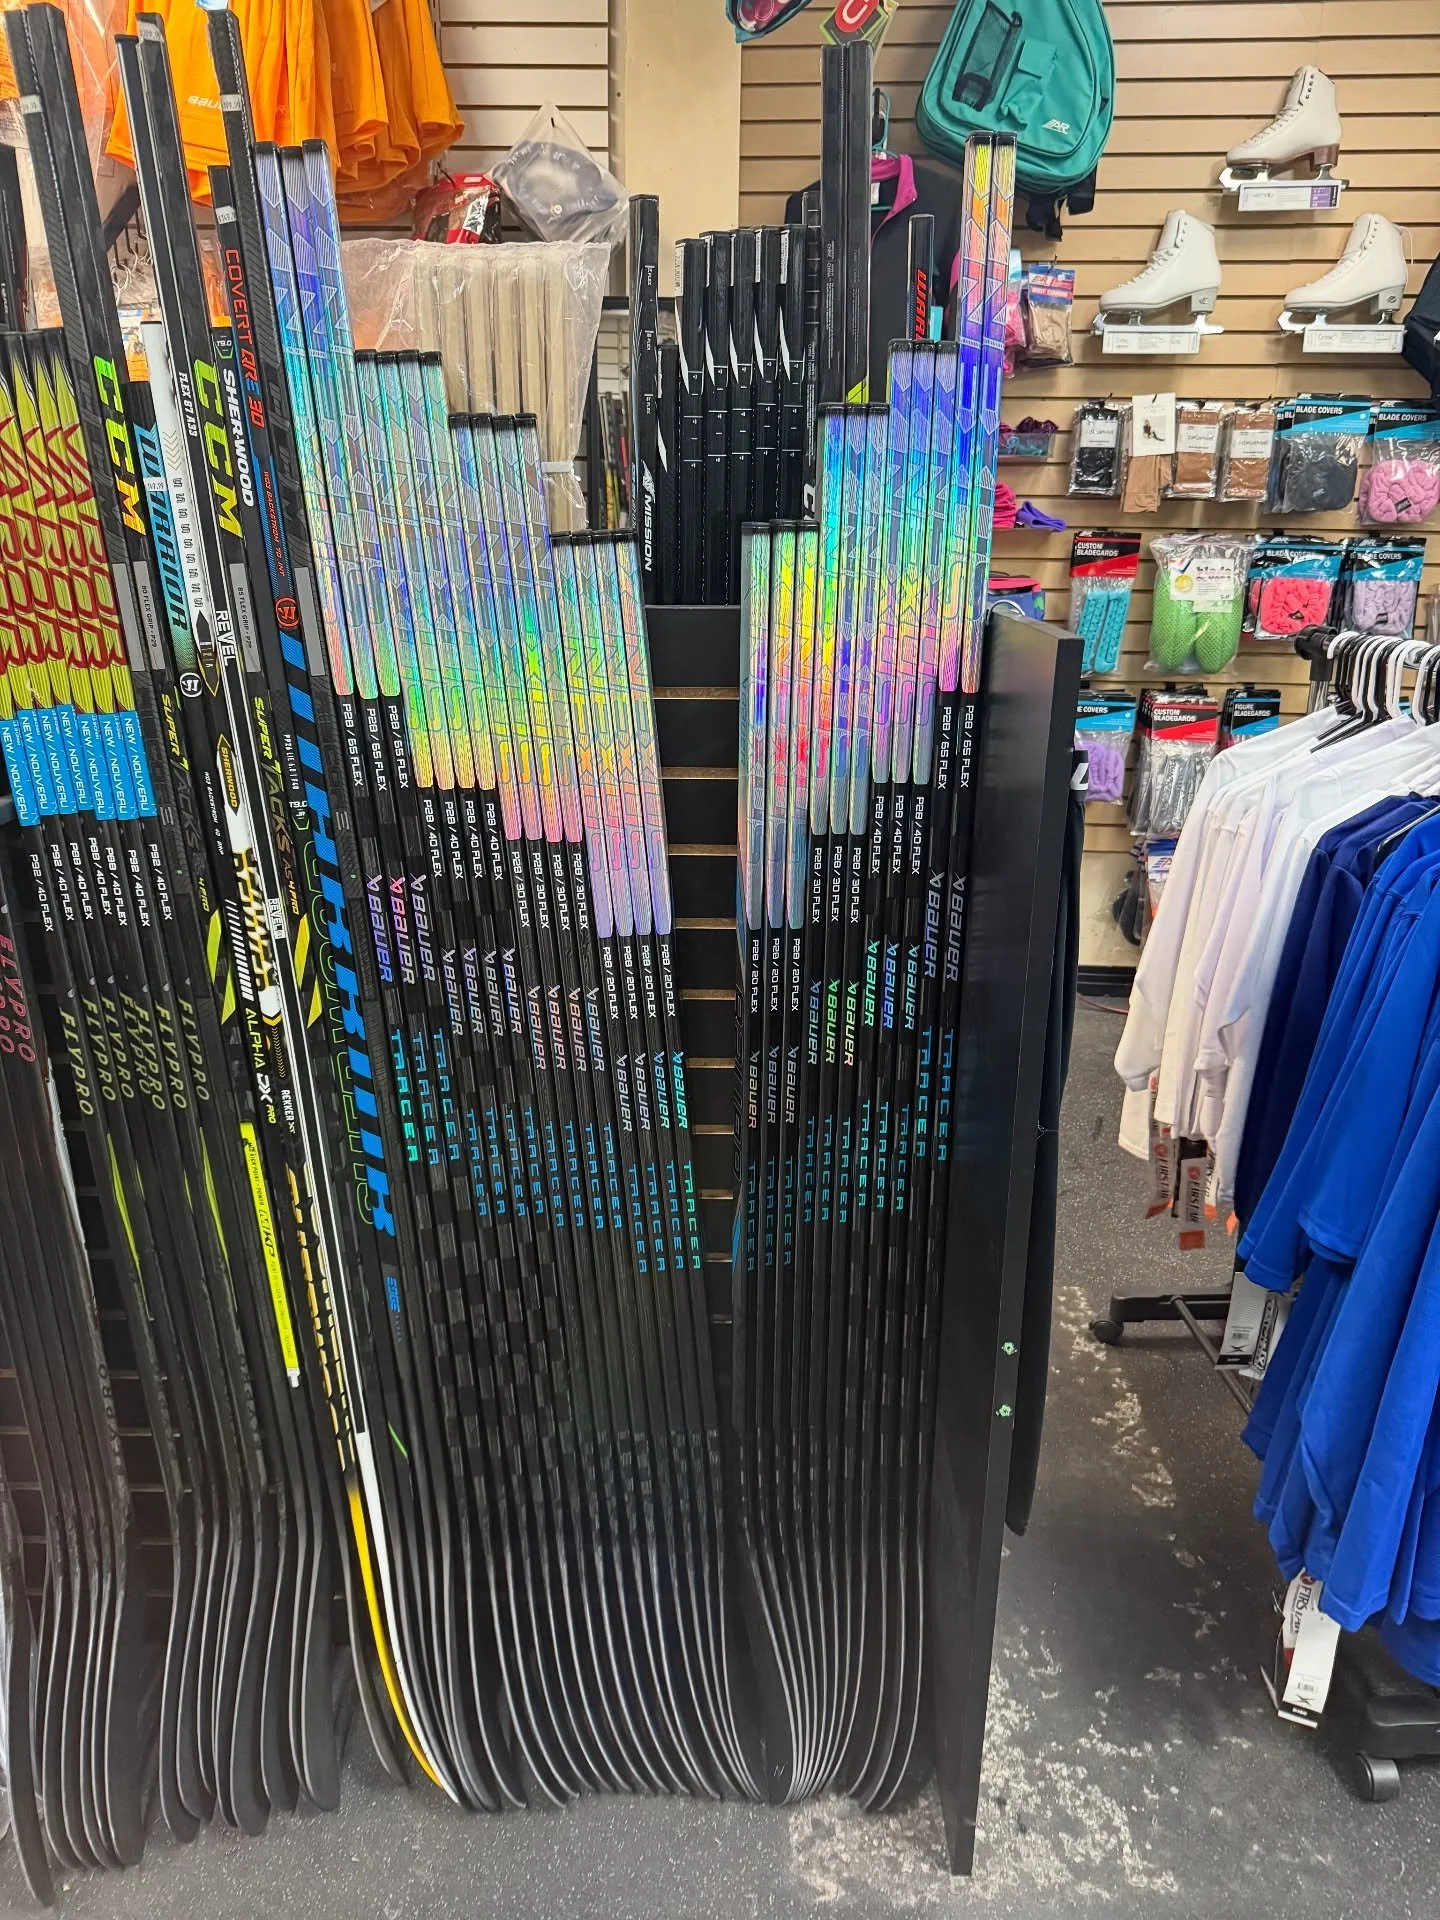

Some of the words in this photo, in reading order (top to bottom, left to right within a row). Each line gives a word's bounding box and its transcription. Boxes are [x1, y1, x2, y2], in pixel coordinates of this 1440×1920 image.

[225, 250, 253, 344] COVERT
[179, 372, 191, 398] FLEX
[242, 348, 260, 396] QRE
[184, 400, 194, 414] 87
[186, 414, 198, 436] A33
[222, 369, 254, 507] SHER-WOOD
[248, 396, 264, 428] 30
[94, 356, 146, 536] CCM
[194, 360, 243, 538] CCM
[137, 428, 188, 630] WARRIOR
[144, 596, 152, 612] FLEX
[216, 610, 236, 666] REVEL
[162, 694, 181, 760] SUPER
[254, 696, 273, 760] SUPER
[342, 704, 354, 728] P28
[348, 738, 358, 755] 65
[942, 707, 952, 730] P28
[21, 717, 34, 743] NEW
[30, 754, 48, 810] NOUVEAU
[81, 721, 94, 748] NEW
[88, 758, 107, 814] NOUVEAU
[124, 718, 138, 745] NEW
[132, 756, 149, 810] NOUVEAU
[221, 747, 238, 808] SHERWOOD
[350, 756, 363, 786] FLEX
[938, 760, 948, 790] FLEX
[940, 742, 950, 758] 65
[30, 854, 41, 876] P92
[70, 842, 82, 868] P88
[78, 876, 86, 890] 40
[512, 852, 522, 874] P28
[38, 886, 47, 901] 40
[40, 904, 54, 932] FLEX
[80, 892, 94, 920] FLEX
[269, 898, 283, 930] REVEL
[516, 884, 526, 898] 30
[518, 900, 530, 927] FLEX
[368, 894, 392, 983] BAUER
[391, 896, 414, 984] BAUER
[412, 894, 436, 982] BAUER
[924, 890, 940, 978] BAUER
[947, 894, 964, 982] BAUER
[464, 964, 484, 1034] BAUER
[504, 964, 522, 1034] BAUER
[883, 958, 896, 1028] BAUER
[550, 1001, 566, 1070] BAUER
[826, 994, 838, 1063] BAUER
[844, 997, 856, 1066] BAUER
[244, 1008, 264, 1068] ALPHA
[266, 1104, 277, 1124] PRO
[673, 1066, 687, 1128] BAUER
[748, 1064, 758, 1128] BAUER
[786, 1060, 796, 1124] BAUER
[281, 1090, 294, 1122] REKKER
[616, 1069, 632, 1132] BAUER
